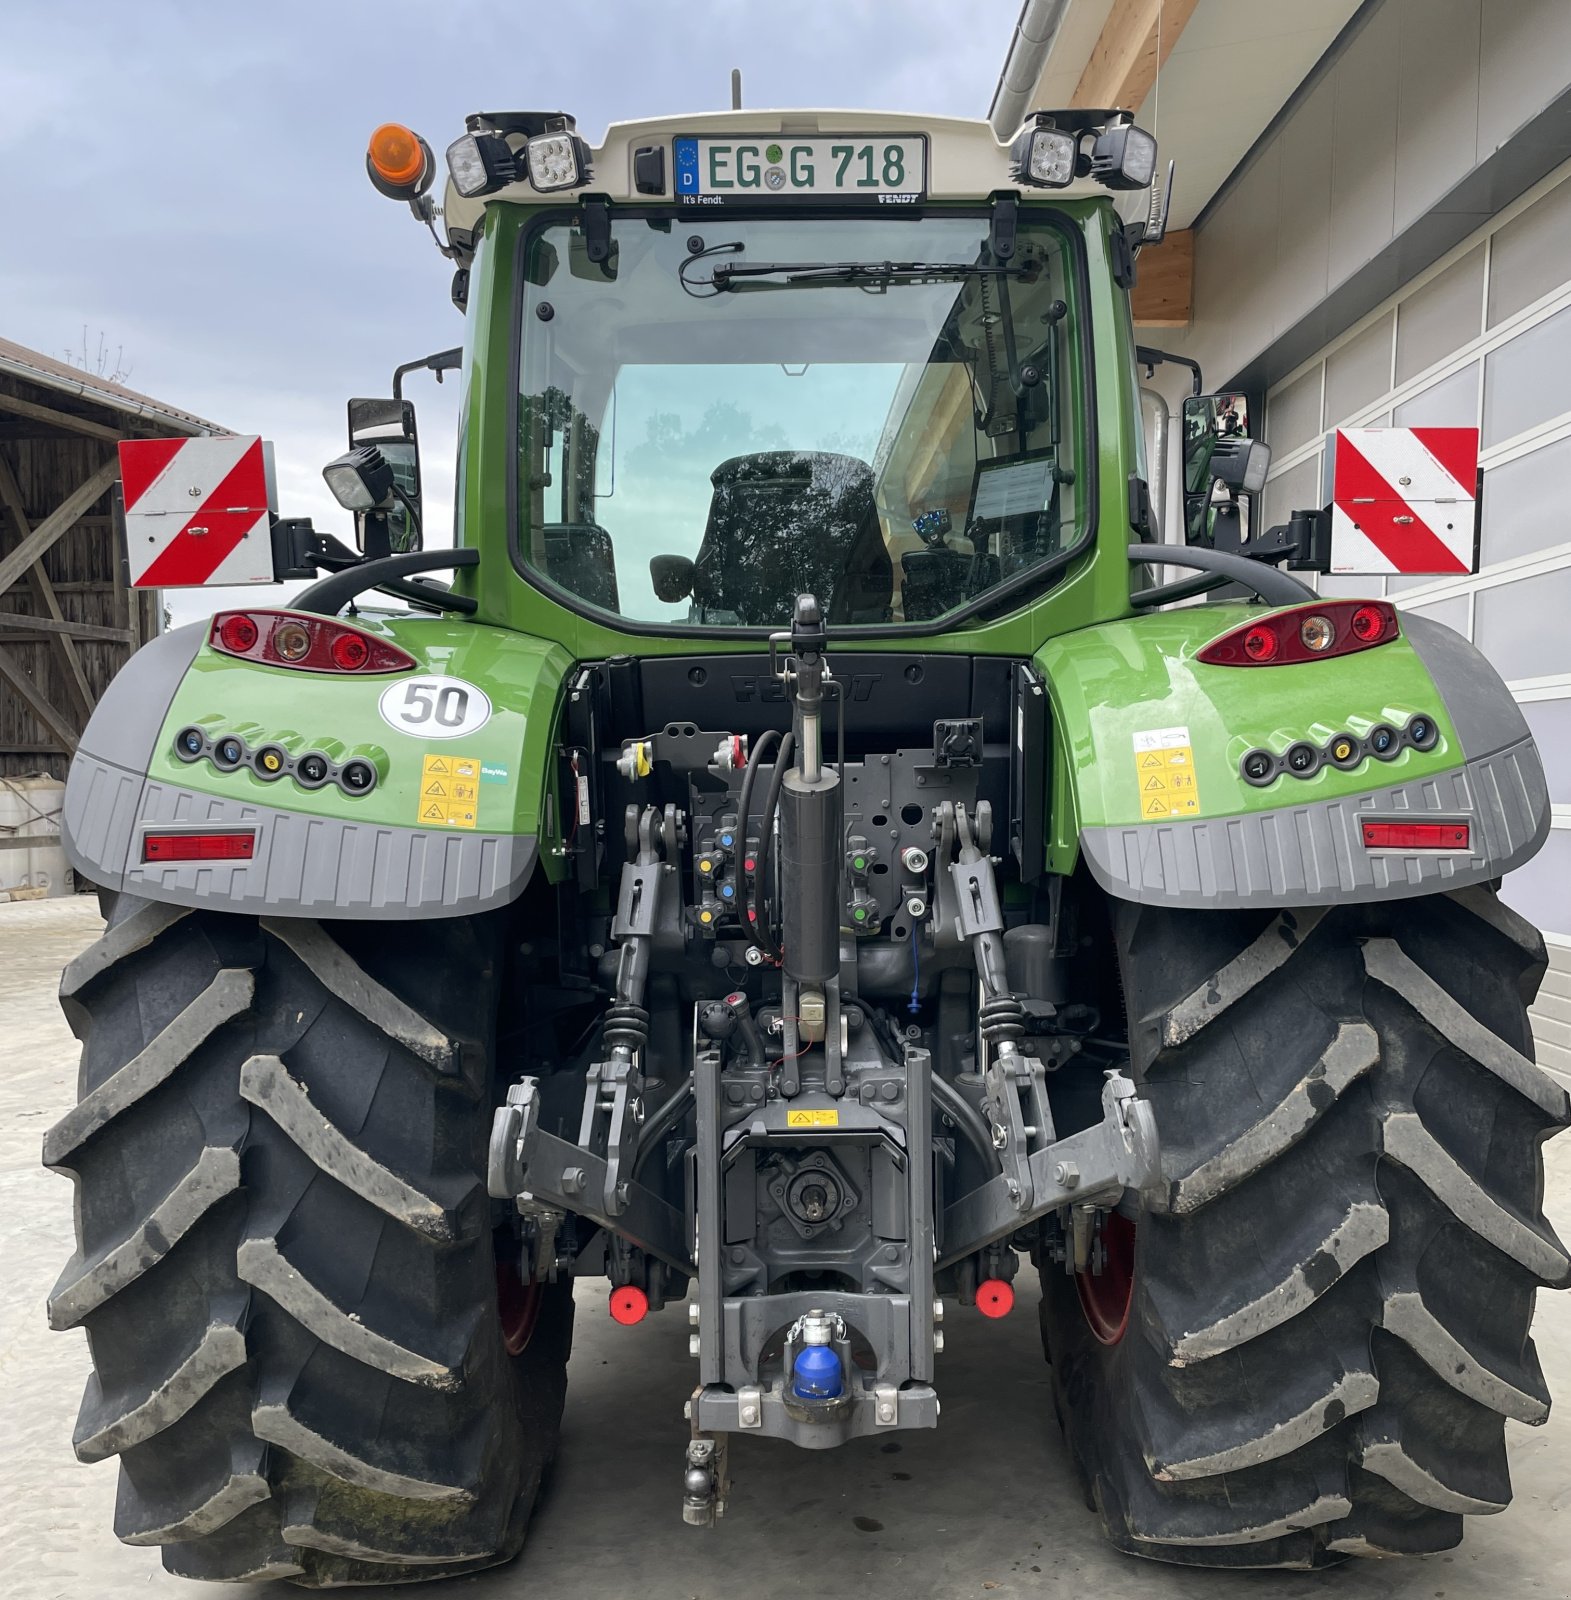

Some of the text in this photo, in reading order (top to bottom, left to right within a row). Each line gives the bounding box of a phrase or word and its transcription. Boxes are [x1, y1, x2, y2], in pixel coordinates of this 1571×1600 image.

[708, 145, 905, 188] EG G 718
[683, 173, 693, 186] D
[683, 195, 725, 205] It's Fendt.
[878, 194, 919, 204] FENDT
[400, 683, 469, 727] 50
